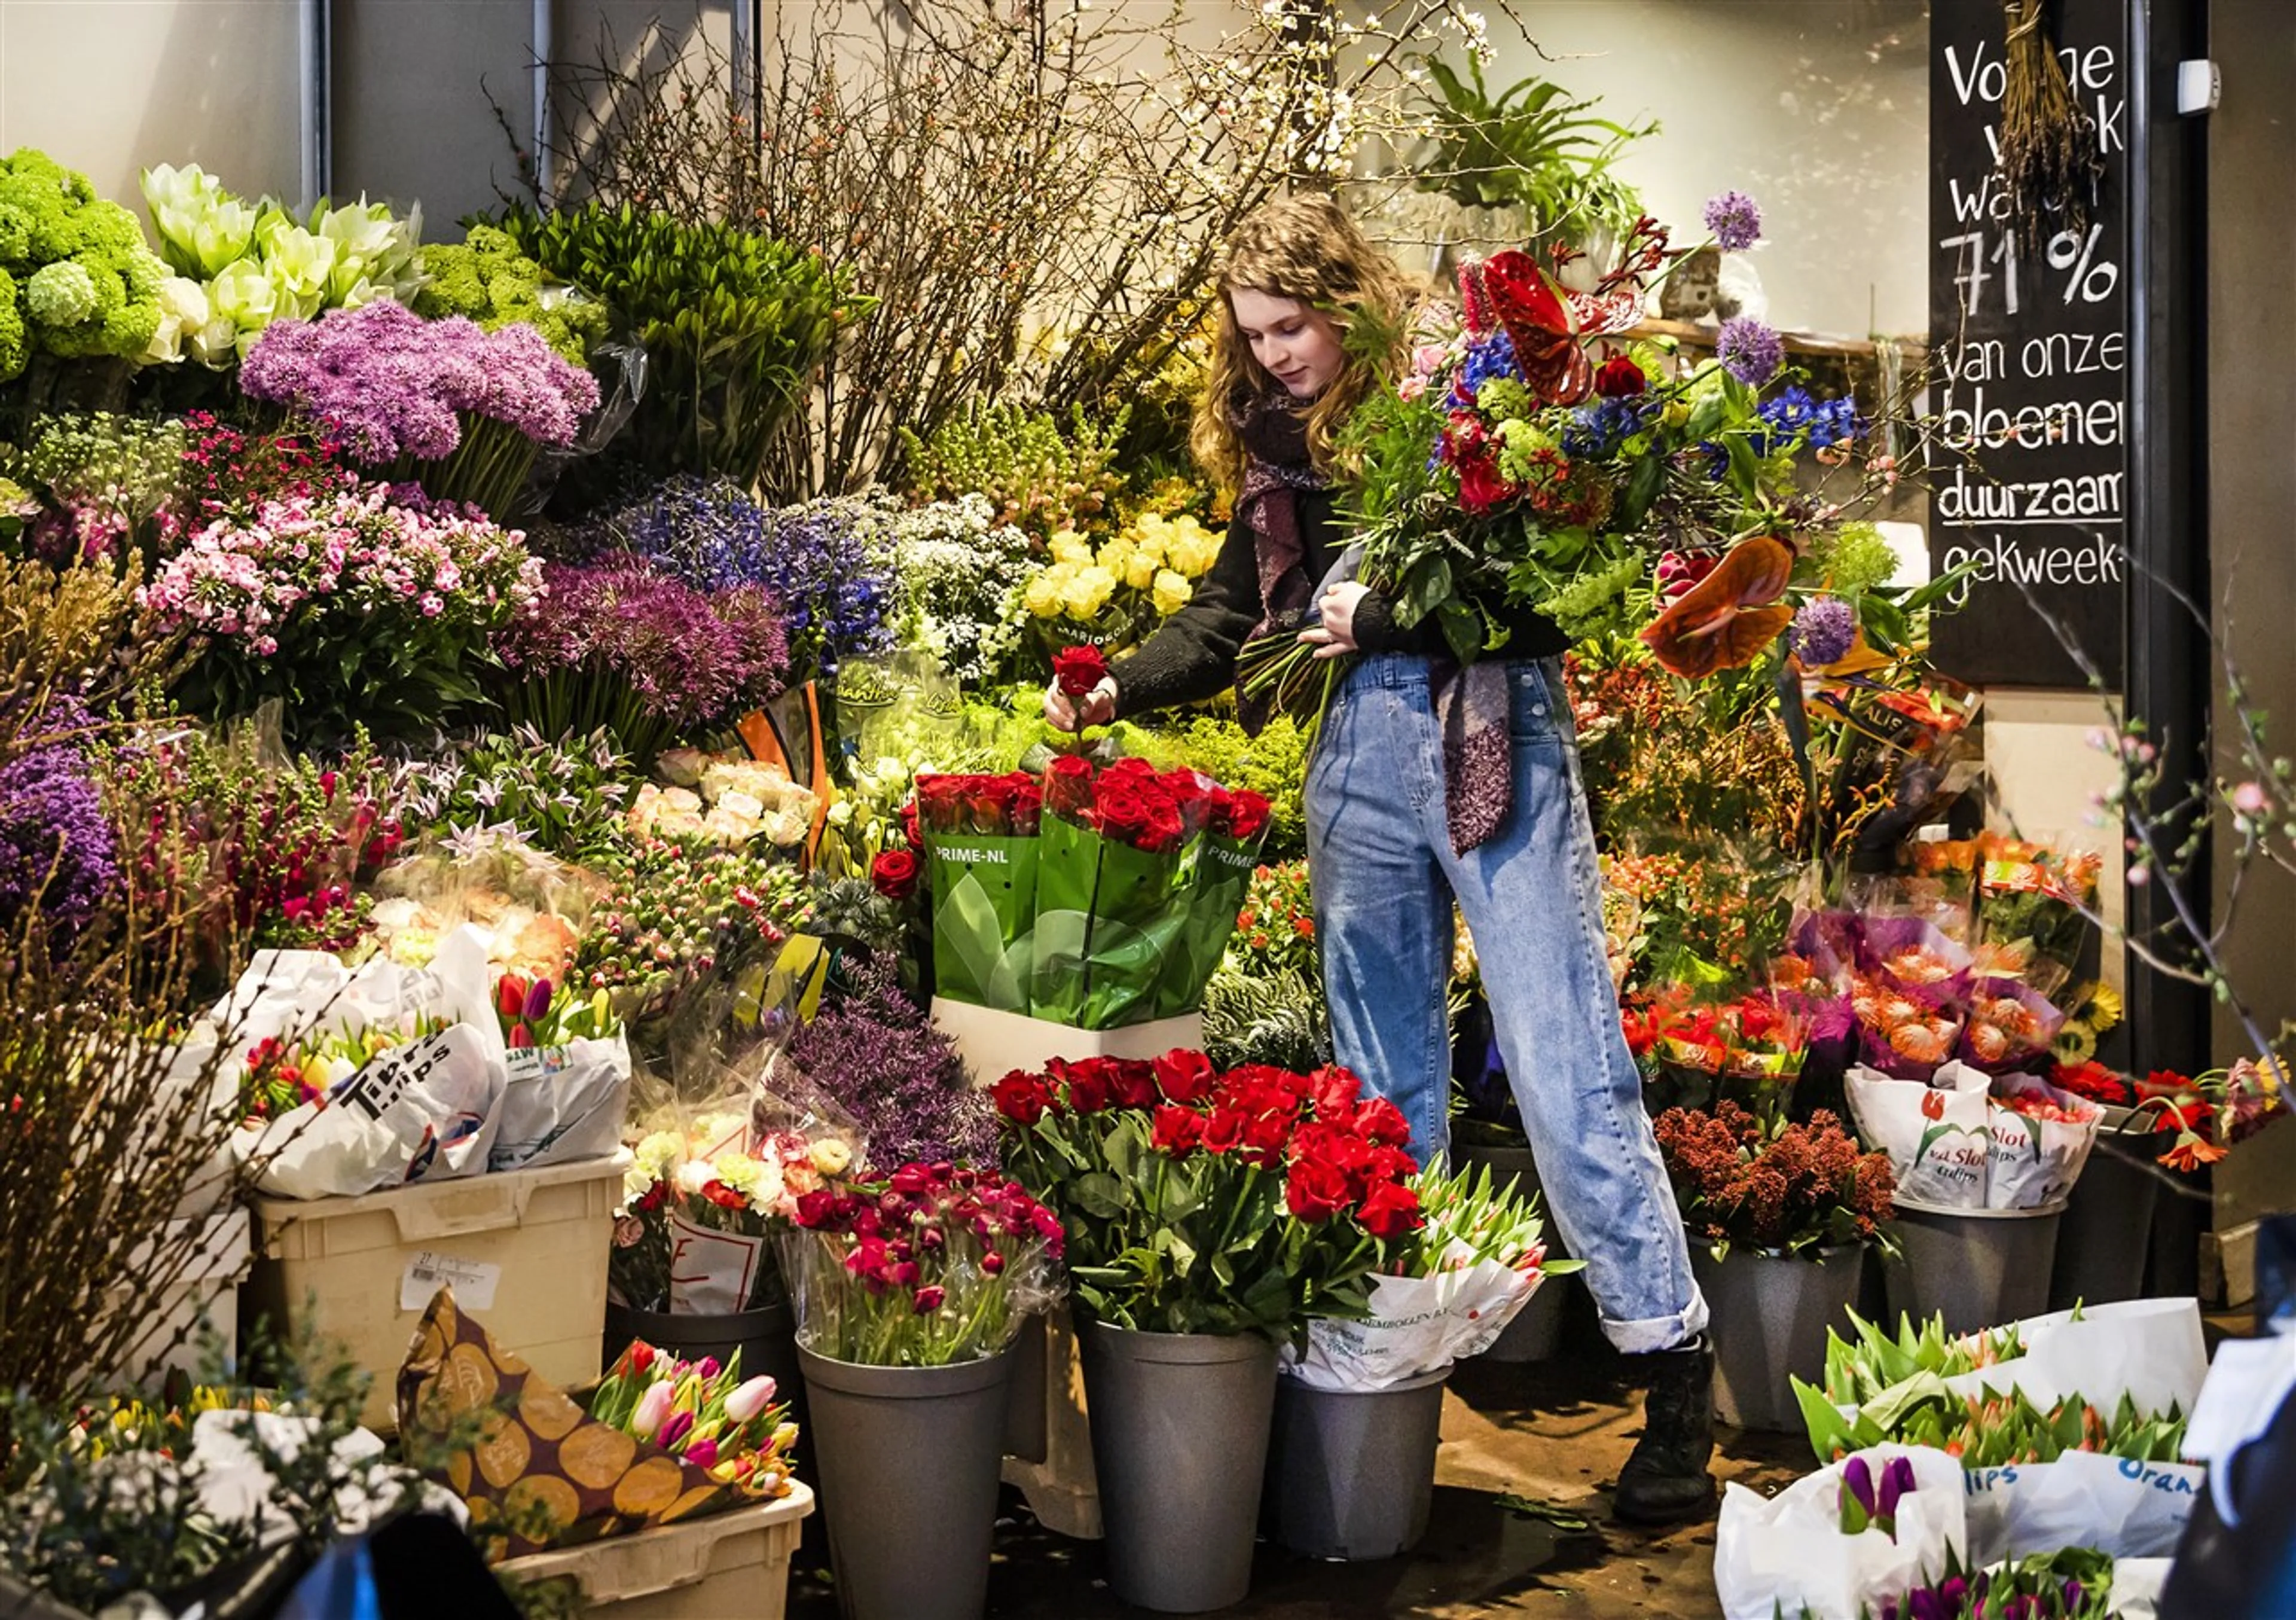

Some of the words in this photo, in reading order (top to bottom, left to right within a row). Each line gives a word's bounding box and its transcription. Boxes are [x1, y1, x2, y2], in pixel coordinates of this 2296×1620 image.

[1940, 228, 2018, 316] 71
[2046, 222, 2118, 306] %
[2022, 332, 2124, 378] onze
[1943, 533, 2124, 605] gekweek
